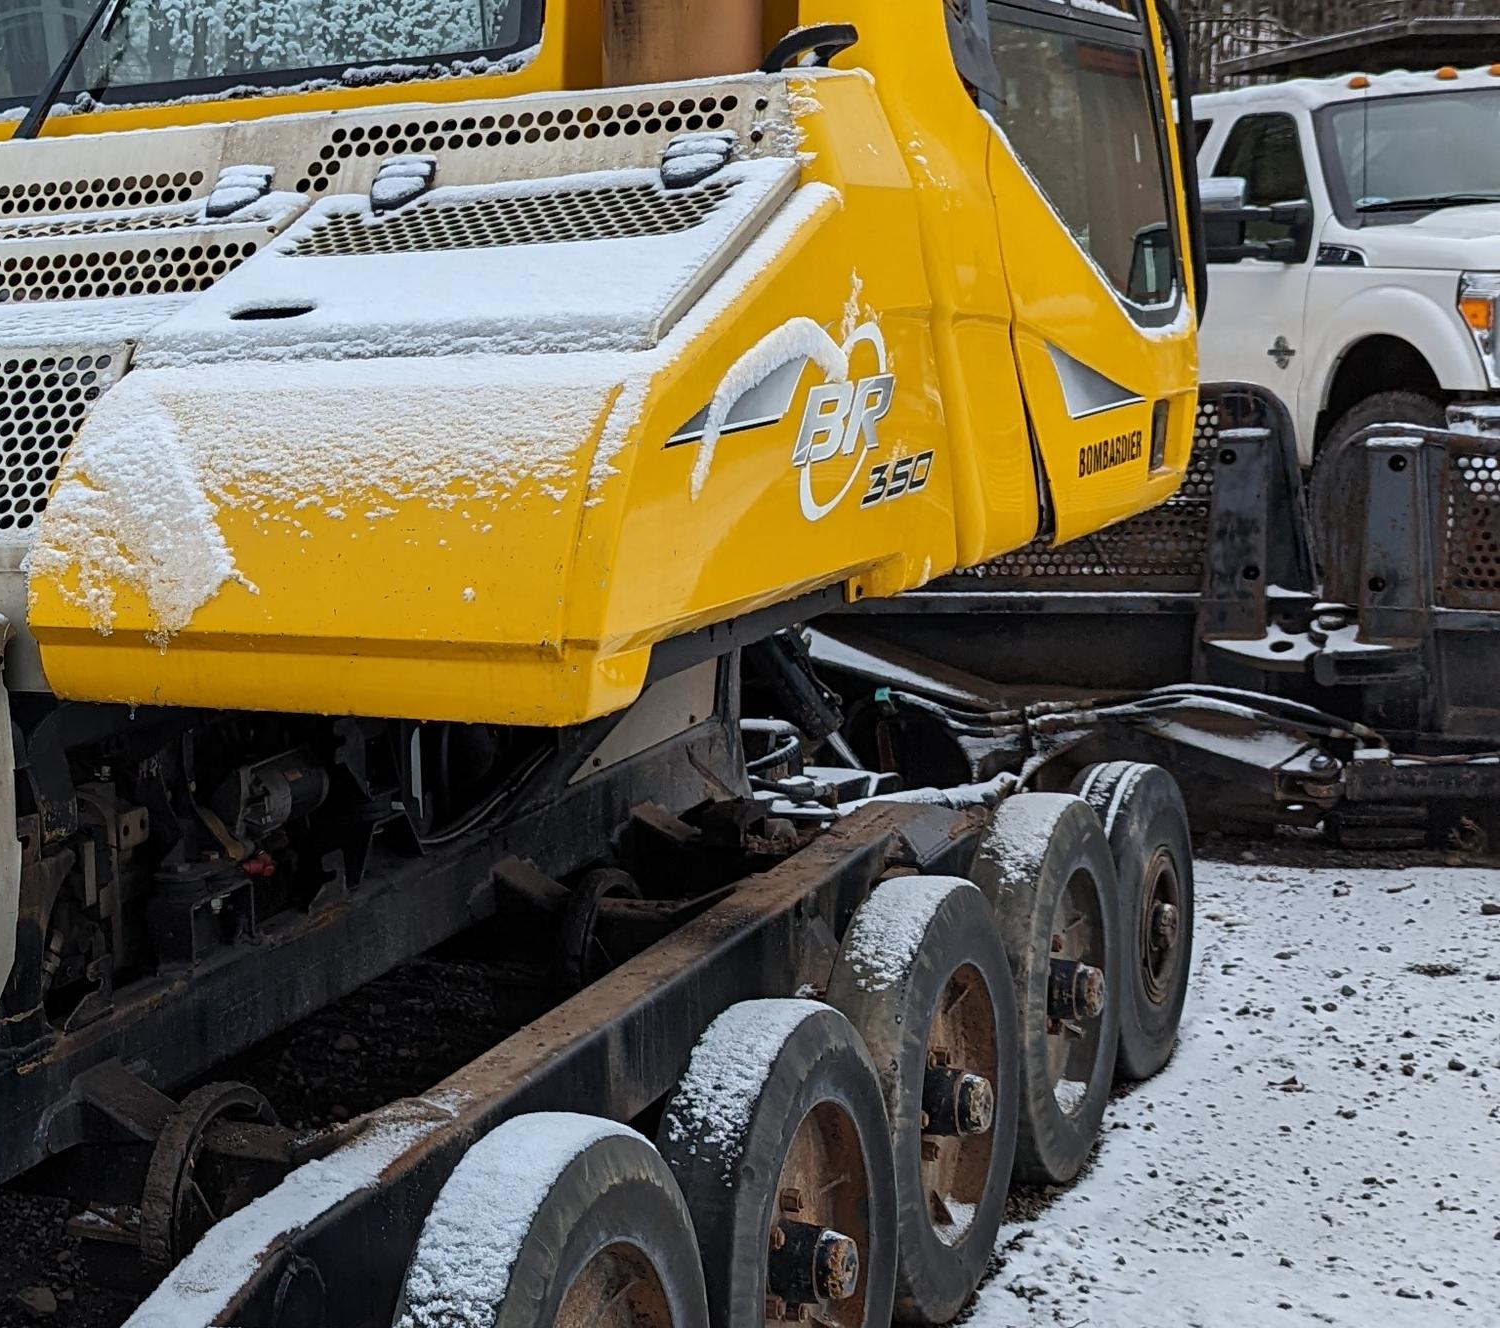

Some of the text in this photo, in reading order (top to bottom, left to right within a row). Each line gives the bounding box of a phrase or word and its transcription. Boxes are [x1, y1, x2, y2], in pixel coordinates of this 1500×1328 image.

[792, 373, 896, 467] BR
[860, 448, 935, 510] 350
[1078, 430, 1142, 479] BOMBARDIER
